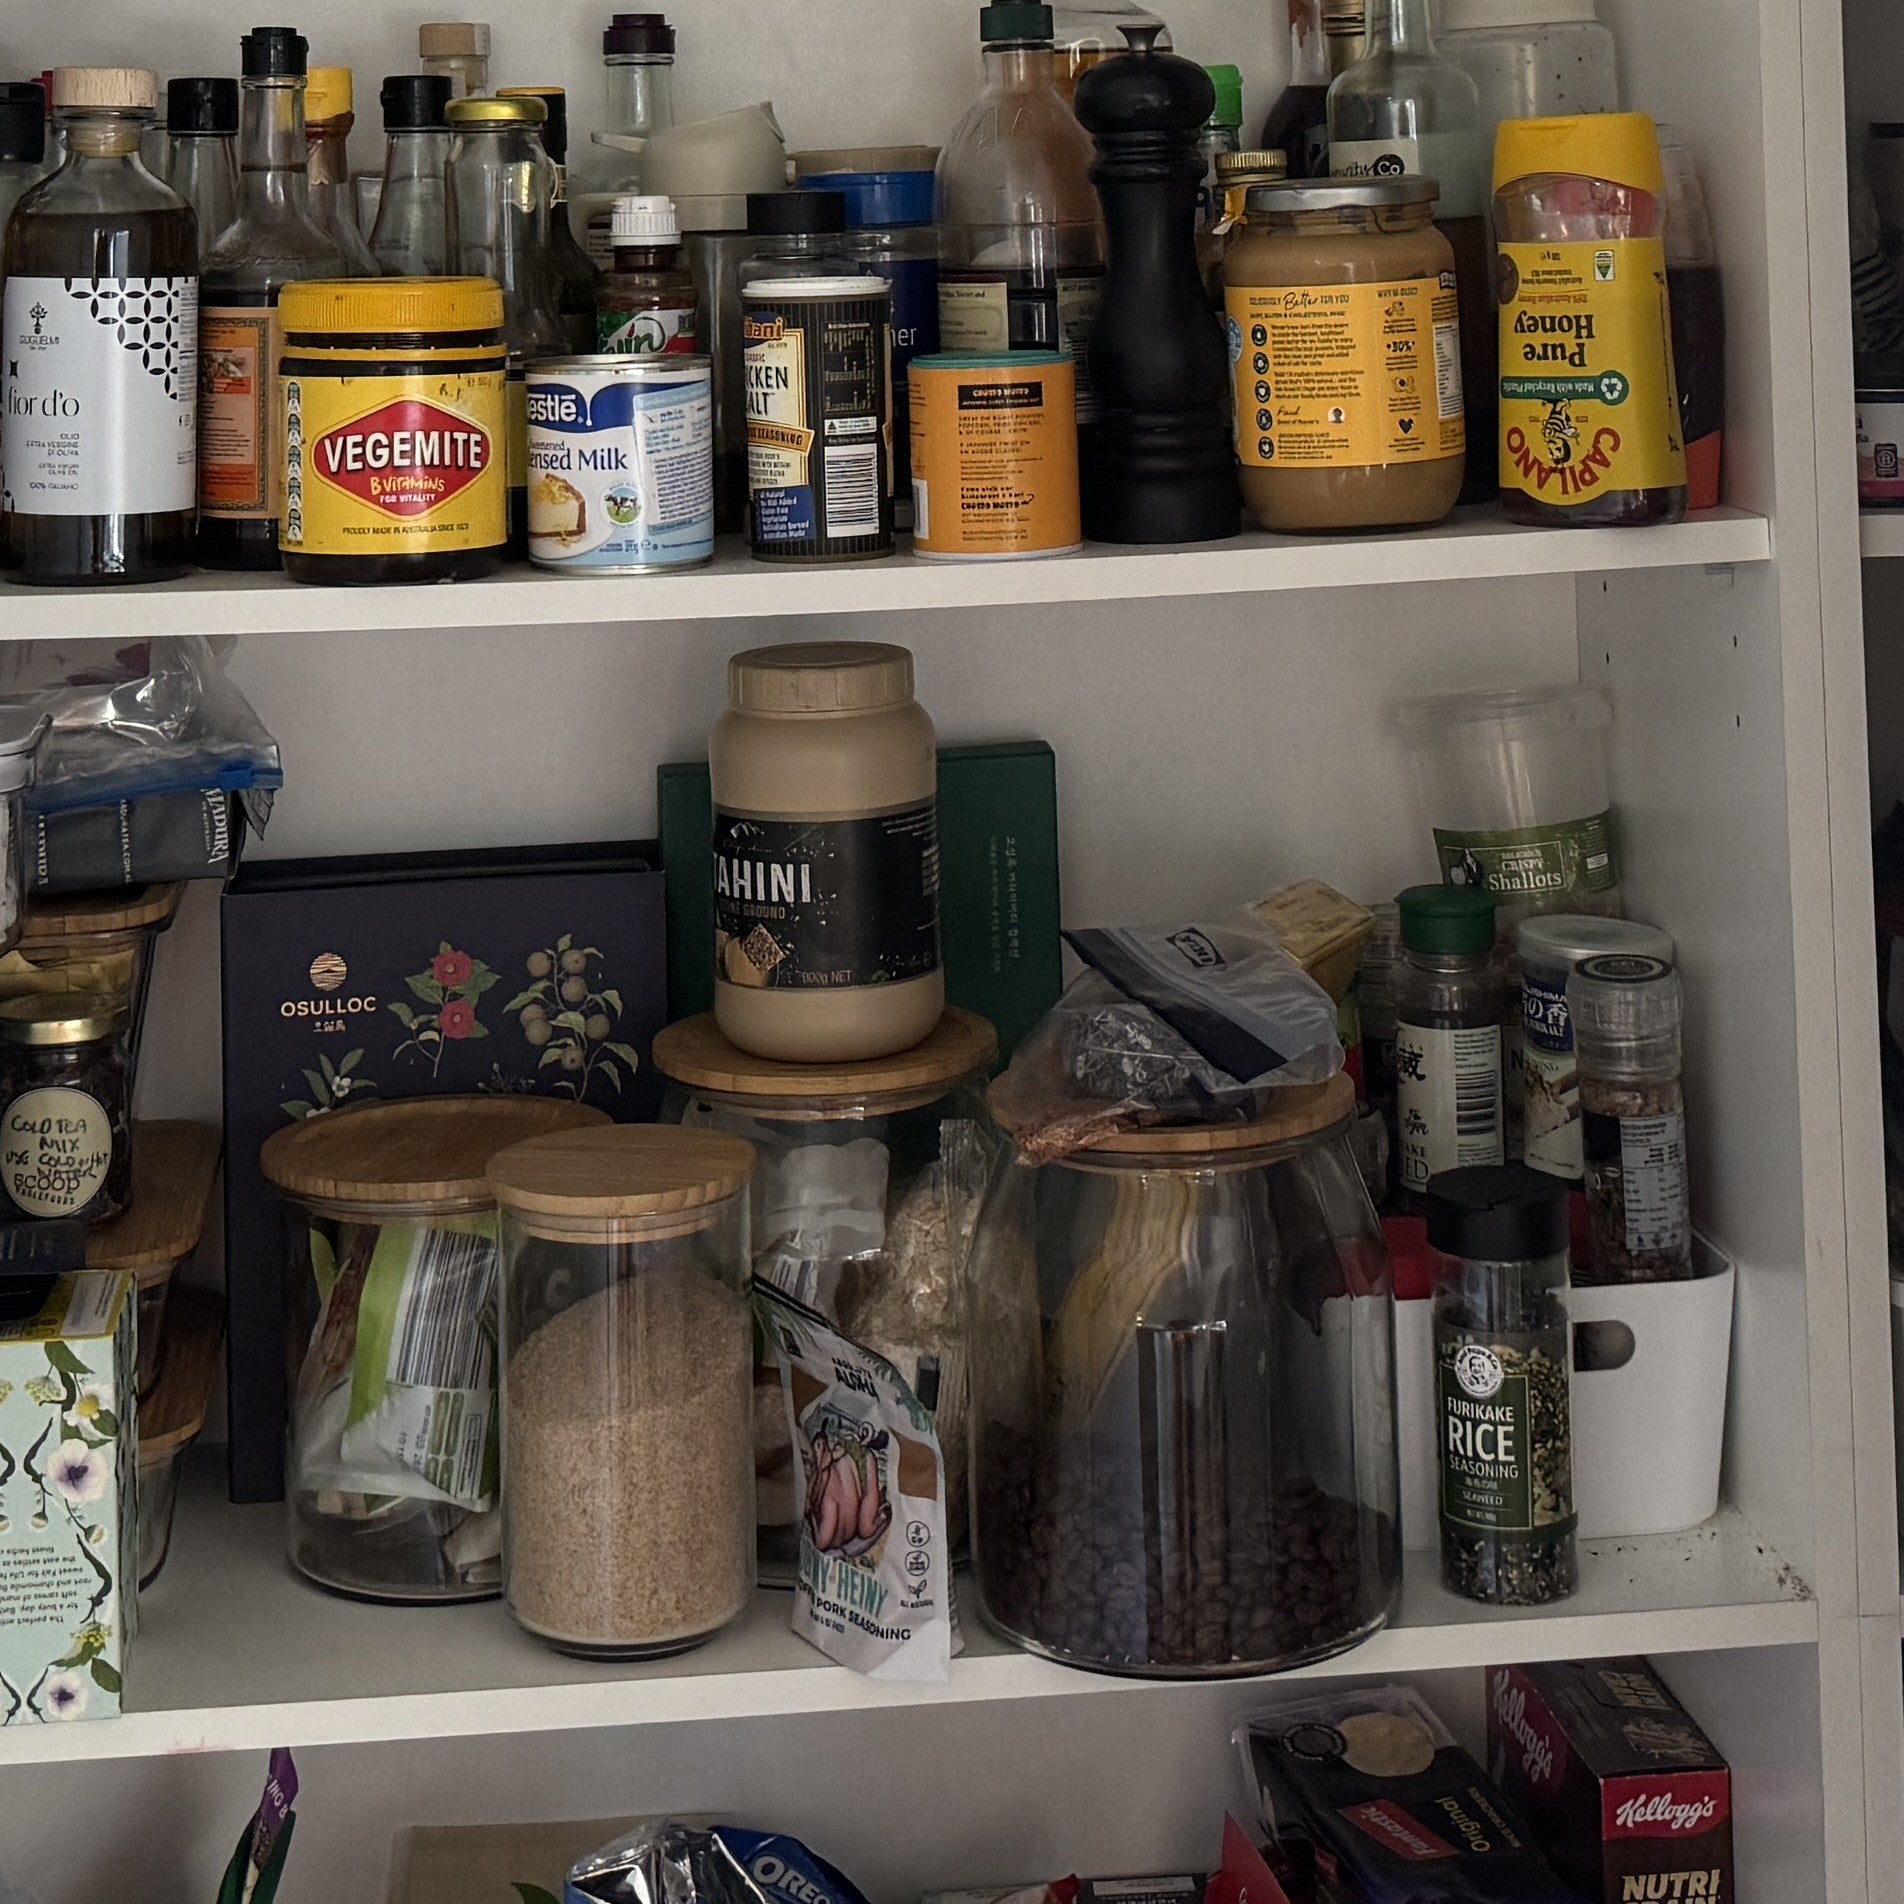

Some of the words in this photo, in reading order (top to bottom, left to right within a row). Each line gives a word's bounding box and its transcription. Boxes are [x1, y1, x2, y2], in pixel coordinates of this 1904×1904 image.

[1378, 161, 1400, 175] Co
[1283, 290, 1318, 310] Better
[1514, 310, 1595, 339] Honey
[1523, 343, 1587, 367] Pure
[1503, 382, 1523, 393] Plastic
[1524, 381, 1555, 393] Recycled
[1556, 382, 1573, 393] with
[1575, 382, 1594, 392] Made
[324, 430, 482, 473] VEGEMITE
[578, 448, 628, 471] Milk
[1507, 427, 1621, 495] CAPILANO
[370, 476, 382, 495] B
[380, 494, 397, 503] FOR
[399, 493, 436, 502] VITALITY
[200, 789, 230, 865] MADURA
[714, 852, 811, 903] AHINI
[1489, 870, 1562, 892] Shallots
[831, 969, 852, 983] NET
[281, 996, 376, 1017] OSULLOC
[56, 1119, 86, 1133] TEA
[39, 1136, 80, 1153] MIX
[14, 1173, 80, 1194] SCOOP
[1448, 1397, 1514, 1422] FURIKAKE
[1448, 1415, 1515, 1462] RICE
[1450, 1454, 1518, 1479] SEASONING
[816, 1598, 846, 1620] PORK
[849, 1611, 911, 1641] SEASONING
[1616, 1792, 1719, 1830] Kellogg's
[1435, 1797, 1492, 1853] Original
[1622, 1870, 1722, 1903] NUTRI
